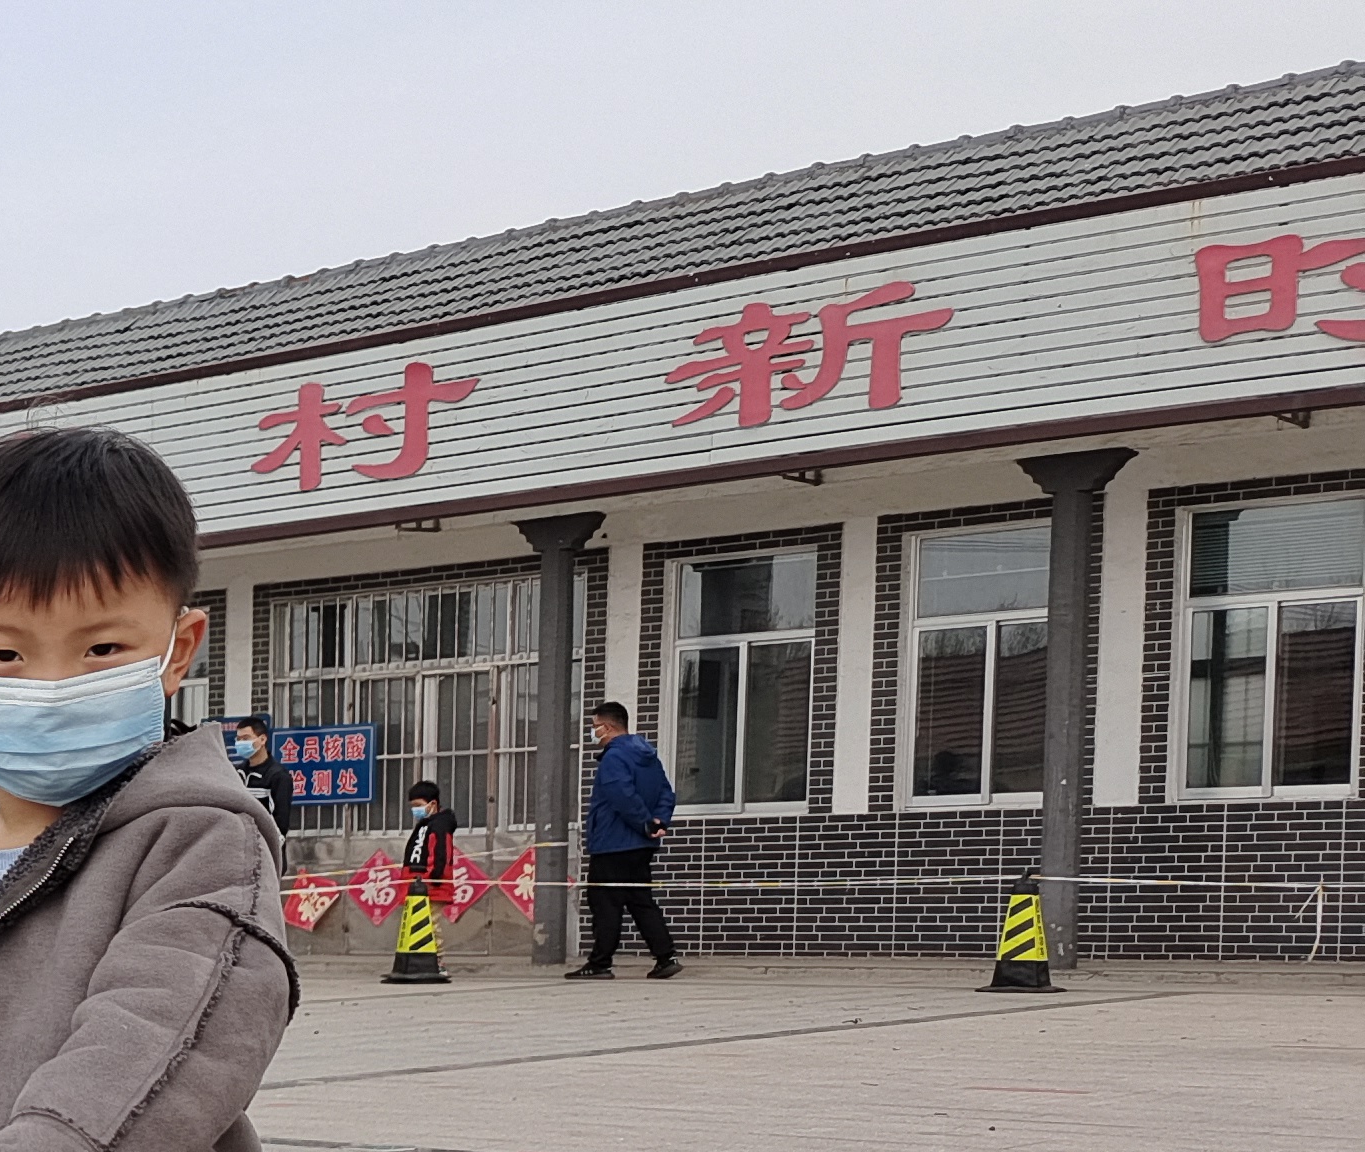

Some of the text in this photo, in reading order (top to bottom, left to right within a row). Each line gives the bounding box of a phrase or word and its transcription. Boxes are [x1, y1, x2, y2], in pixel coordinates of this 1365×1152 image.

[280, 733, 366, 764] 全员核酸
[289, 767, 358, 796] 检测处
[361, 868, 396, 907] 福
